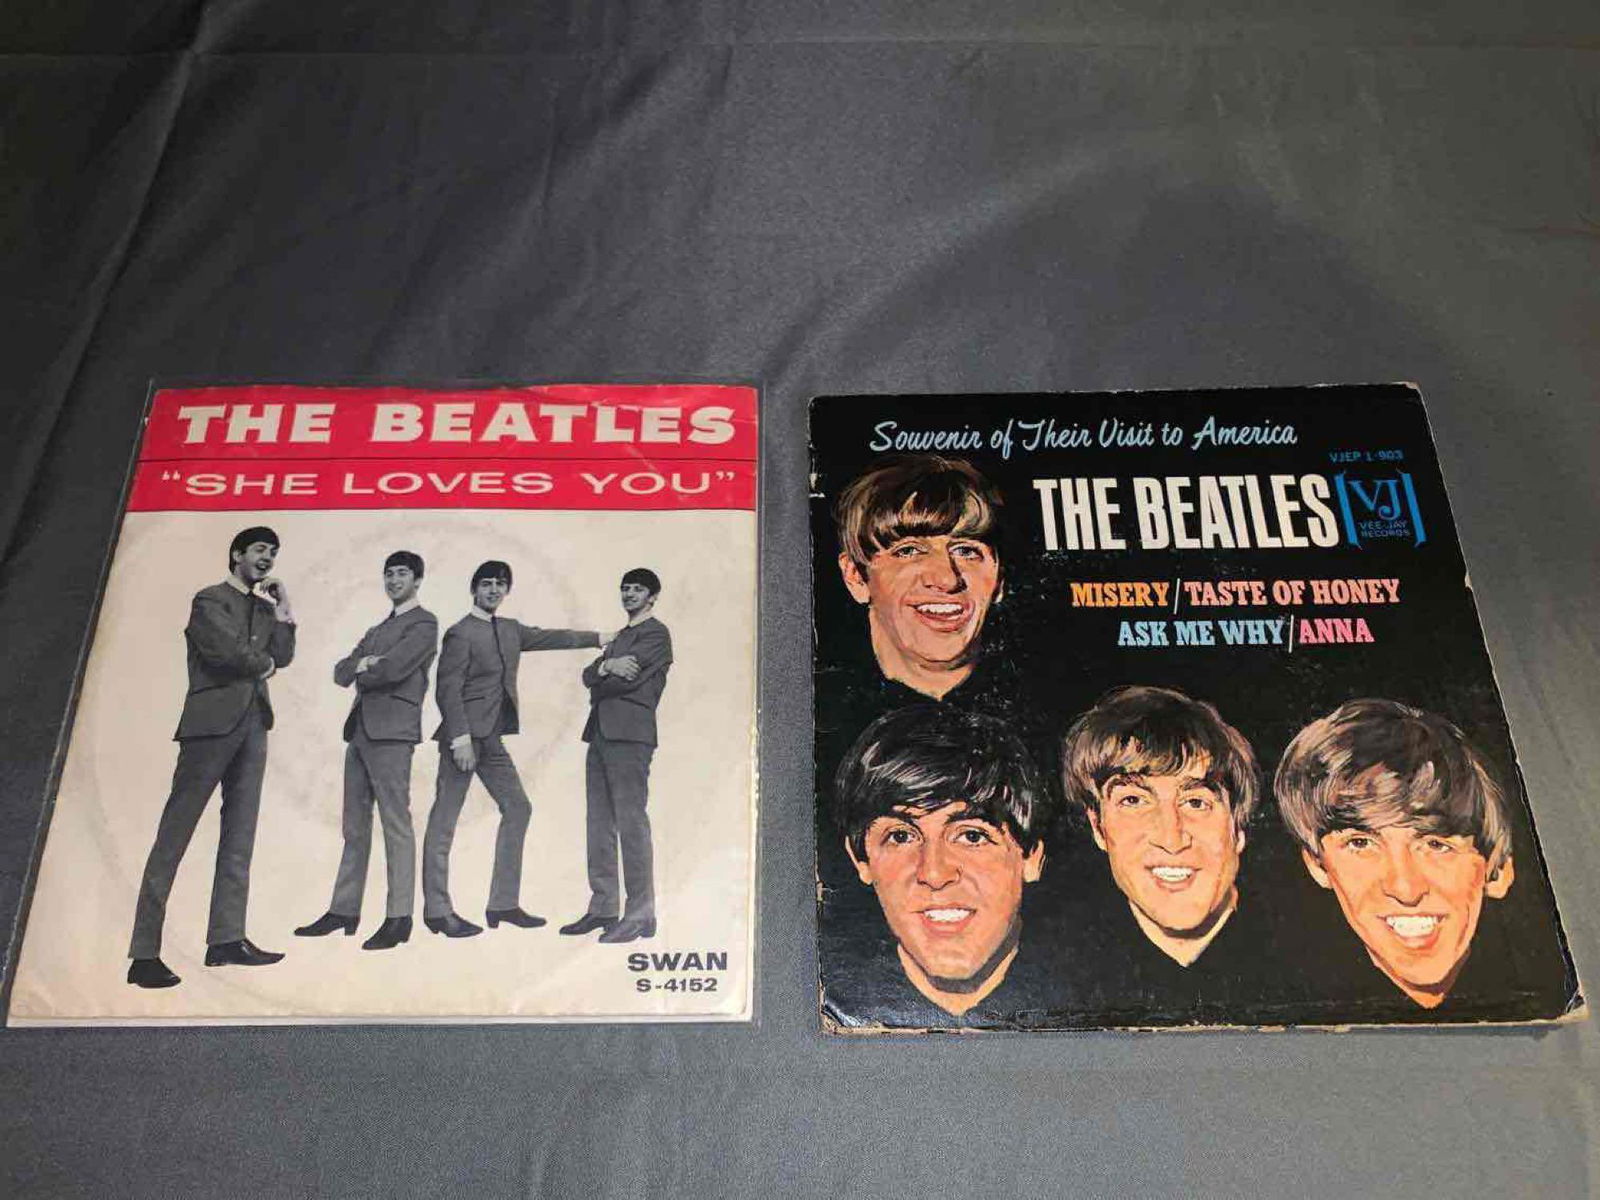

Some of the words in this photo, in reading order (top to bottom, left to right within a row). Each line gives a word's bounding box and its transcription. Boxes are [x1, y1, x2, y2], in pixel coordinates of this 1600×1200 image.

[177, 403, 336, 444] THE
[369, 402, 735, 444] BEATLES
[869, 421, 983, 452] Souvenir
[990, 418, 1014, 460] of
[1017, 418, 1092, 451] Their
[1099, 417, 1155, 448] Visit
[1161, 422, 1184, 446] to
[1191, 415, 1298, 450] America
[343, 472, 553, 495] LOVES
[1032, 478, 1126, 550] THE
[1133, 474, 1339, 549] BEATLES
[1272, 579, 1306, 606] OF
[1309, 577, 1401, 605] HONEY
[1117, 620, 1170, 647] ASK
[1173, 619, 1216, 646] ME
[627, 952, 728, 972] SWAN
[635, 977, 718, 993] S-4152
